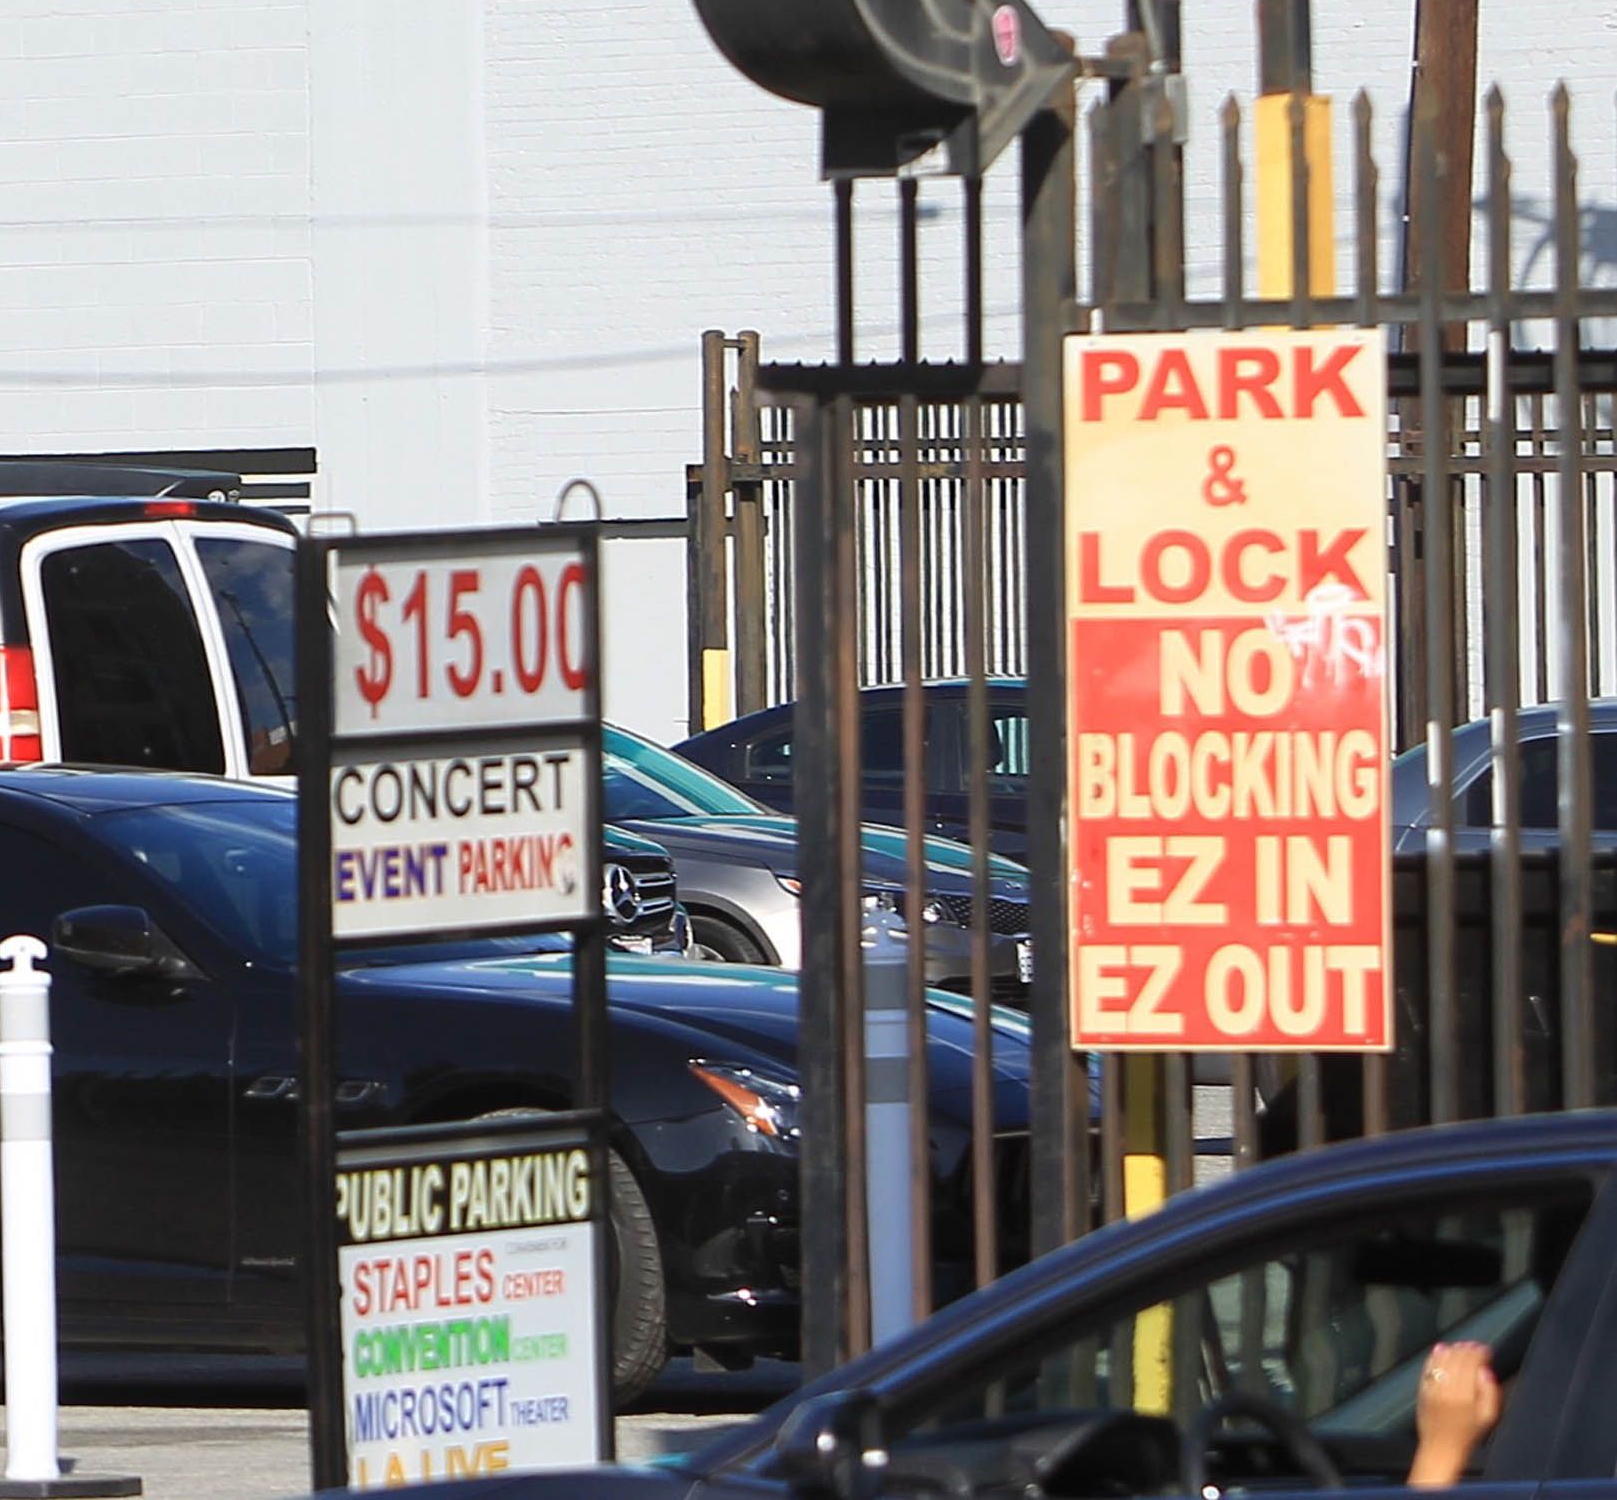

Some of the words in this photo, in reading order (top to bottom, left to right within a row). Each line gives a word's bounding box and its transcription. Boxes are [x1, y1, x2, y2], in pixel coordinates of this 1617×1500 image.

[1080, 345, 1366, 422] PARK
[1201, 444, 1249, 507] &
[1079, 528, 1374, 605] LOCK
[355, 562, 586, 719] $15.00
[1160, 629, 1297, 717] NO
[335, 754, 571, 826] CONCERT
[1079, 728, 1377, 821] BLOCKING
[336, 844, 447, 902] EVENT
[1107, 835, 1227, 926] EZ
[1255, 835, 1353, 926] IN
[1077, 945, 1182, 1035] EZ
[1204, 943, 1381, 1037] OUT
[336, 1163, 444, 1241] PUBLIC
[449, 1149, 590, 1231] PARKING
[352, 1247, 497, 1318] STAPLES
[502, 1268, 565, 1301] CENTER
[354, 1313, 511, 1379] CONVENTION
[354, 1377, 509, 1443] MICROSOFT
[509, 1395, 568, 1428] THEATER
